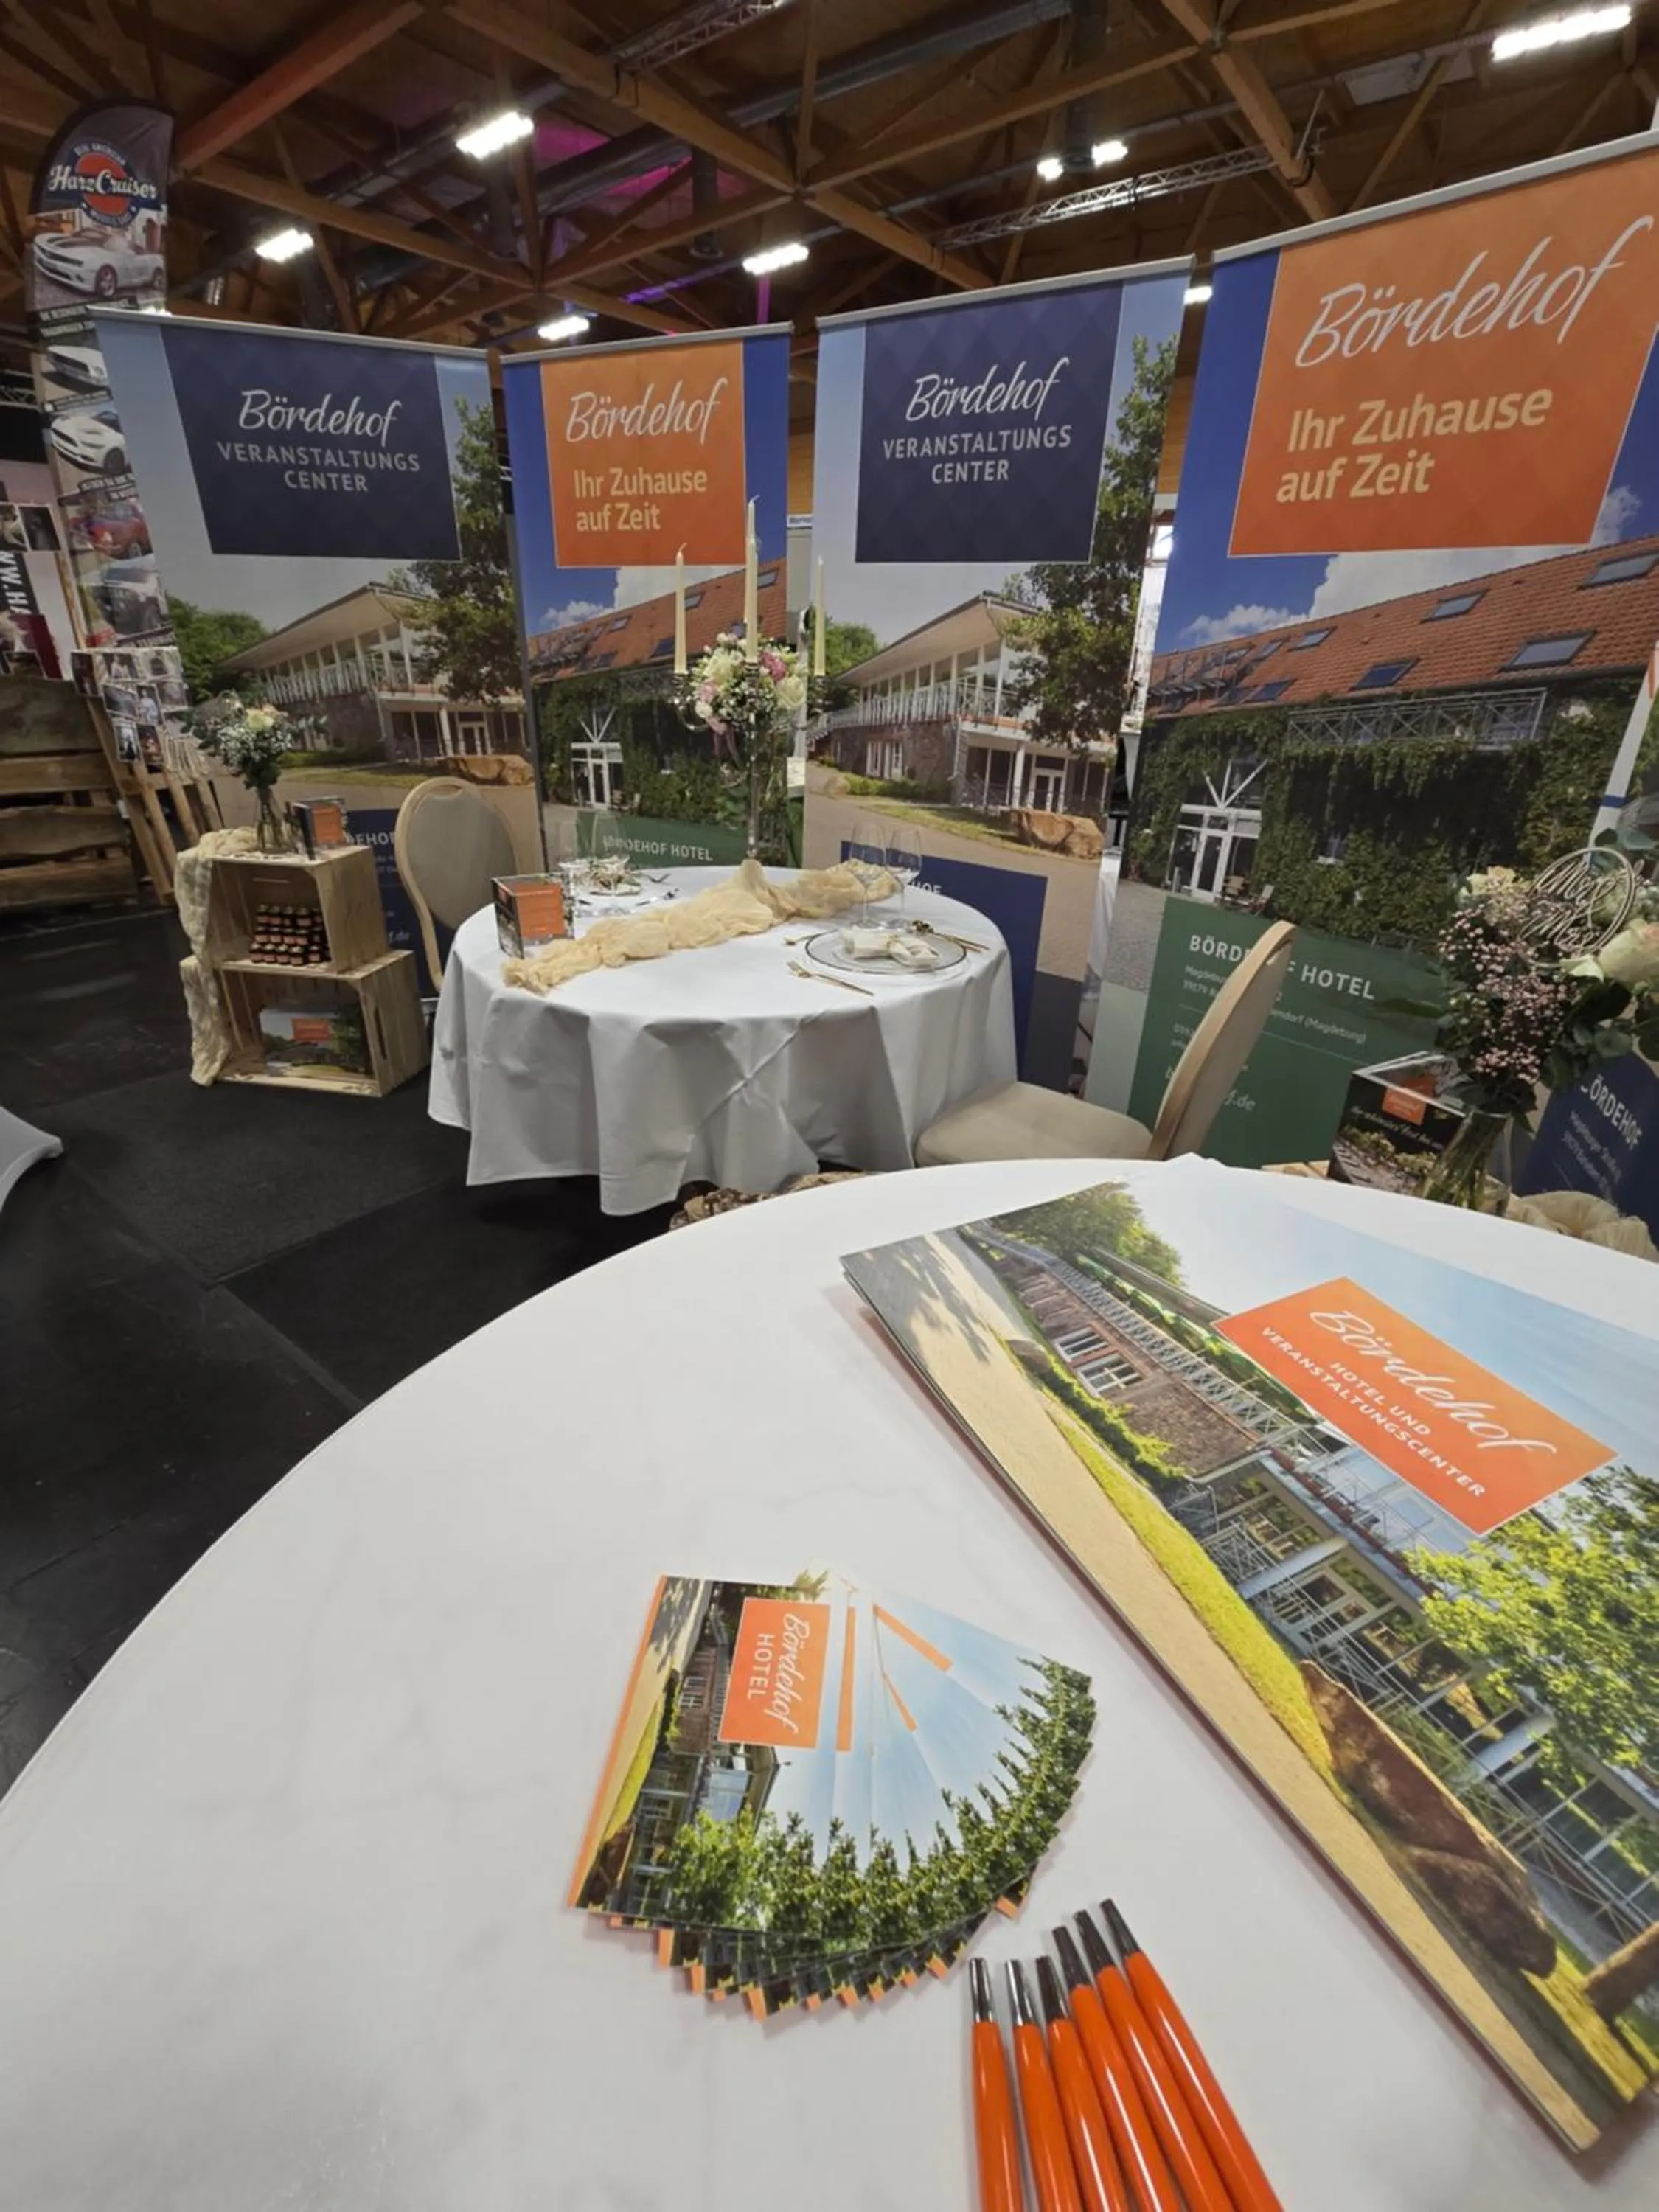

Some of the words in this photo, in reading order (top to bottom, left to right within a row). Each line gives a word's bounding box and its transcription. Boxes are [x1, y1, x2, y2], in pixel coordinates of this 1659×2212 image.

[1295, 215, 1654, 366] Bördehof
[238, 389, 402, 447] Bördehof
[566, 377, 728, 445] Bördehof
[905, 357, 1070, 422] Bördehof
[883, 425, 1072, 459] VERANSTALTUNGS
[1287, 408, 1345, 452] Ihr
[1351, 388, 1554, 445] Zuhause
[217, 442, 420, 472] VERANSTALTUNGS
[285, 470, 368, 492] CENTER
[573, 470, 604, 498] Ihr
[609, 467, 708, 496] Zuhause
[931, 459, 1010, 484] CENTER
[1276, 457, 1346, 503] auf
[1349, 448, 1436, 497] Zeit
[577, 504, 611, 532] auf
[617, 501, 661, 531] Zeit
[671, 844, 714, 861] HOTEL
[1301, 964, 1375, 1001] HOTEL
[1310, 1309, 1557, 1455] Bördehof
[1330, 1362, 1386, 1406] HOTEL
[1389, 1404, 1432, 1437] UND
[1262, 1326, 1488, 1498] VERANSTALTUNGSCENTER
[748, 1633, 775, 1700] HOTEL
[764, 1613, 810, 1735] Bördehof
